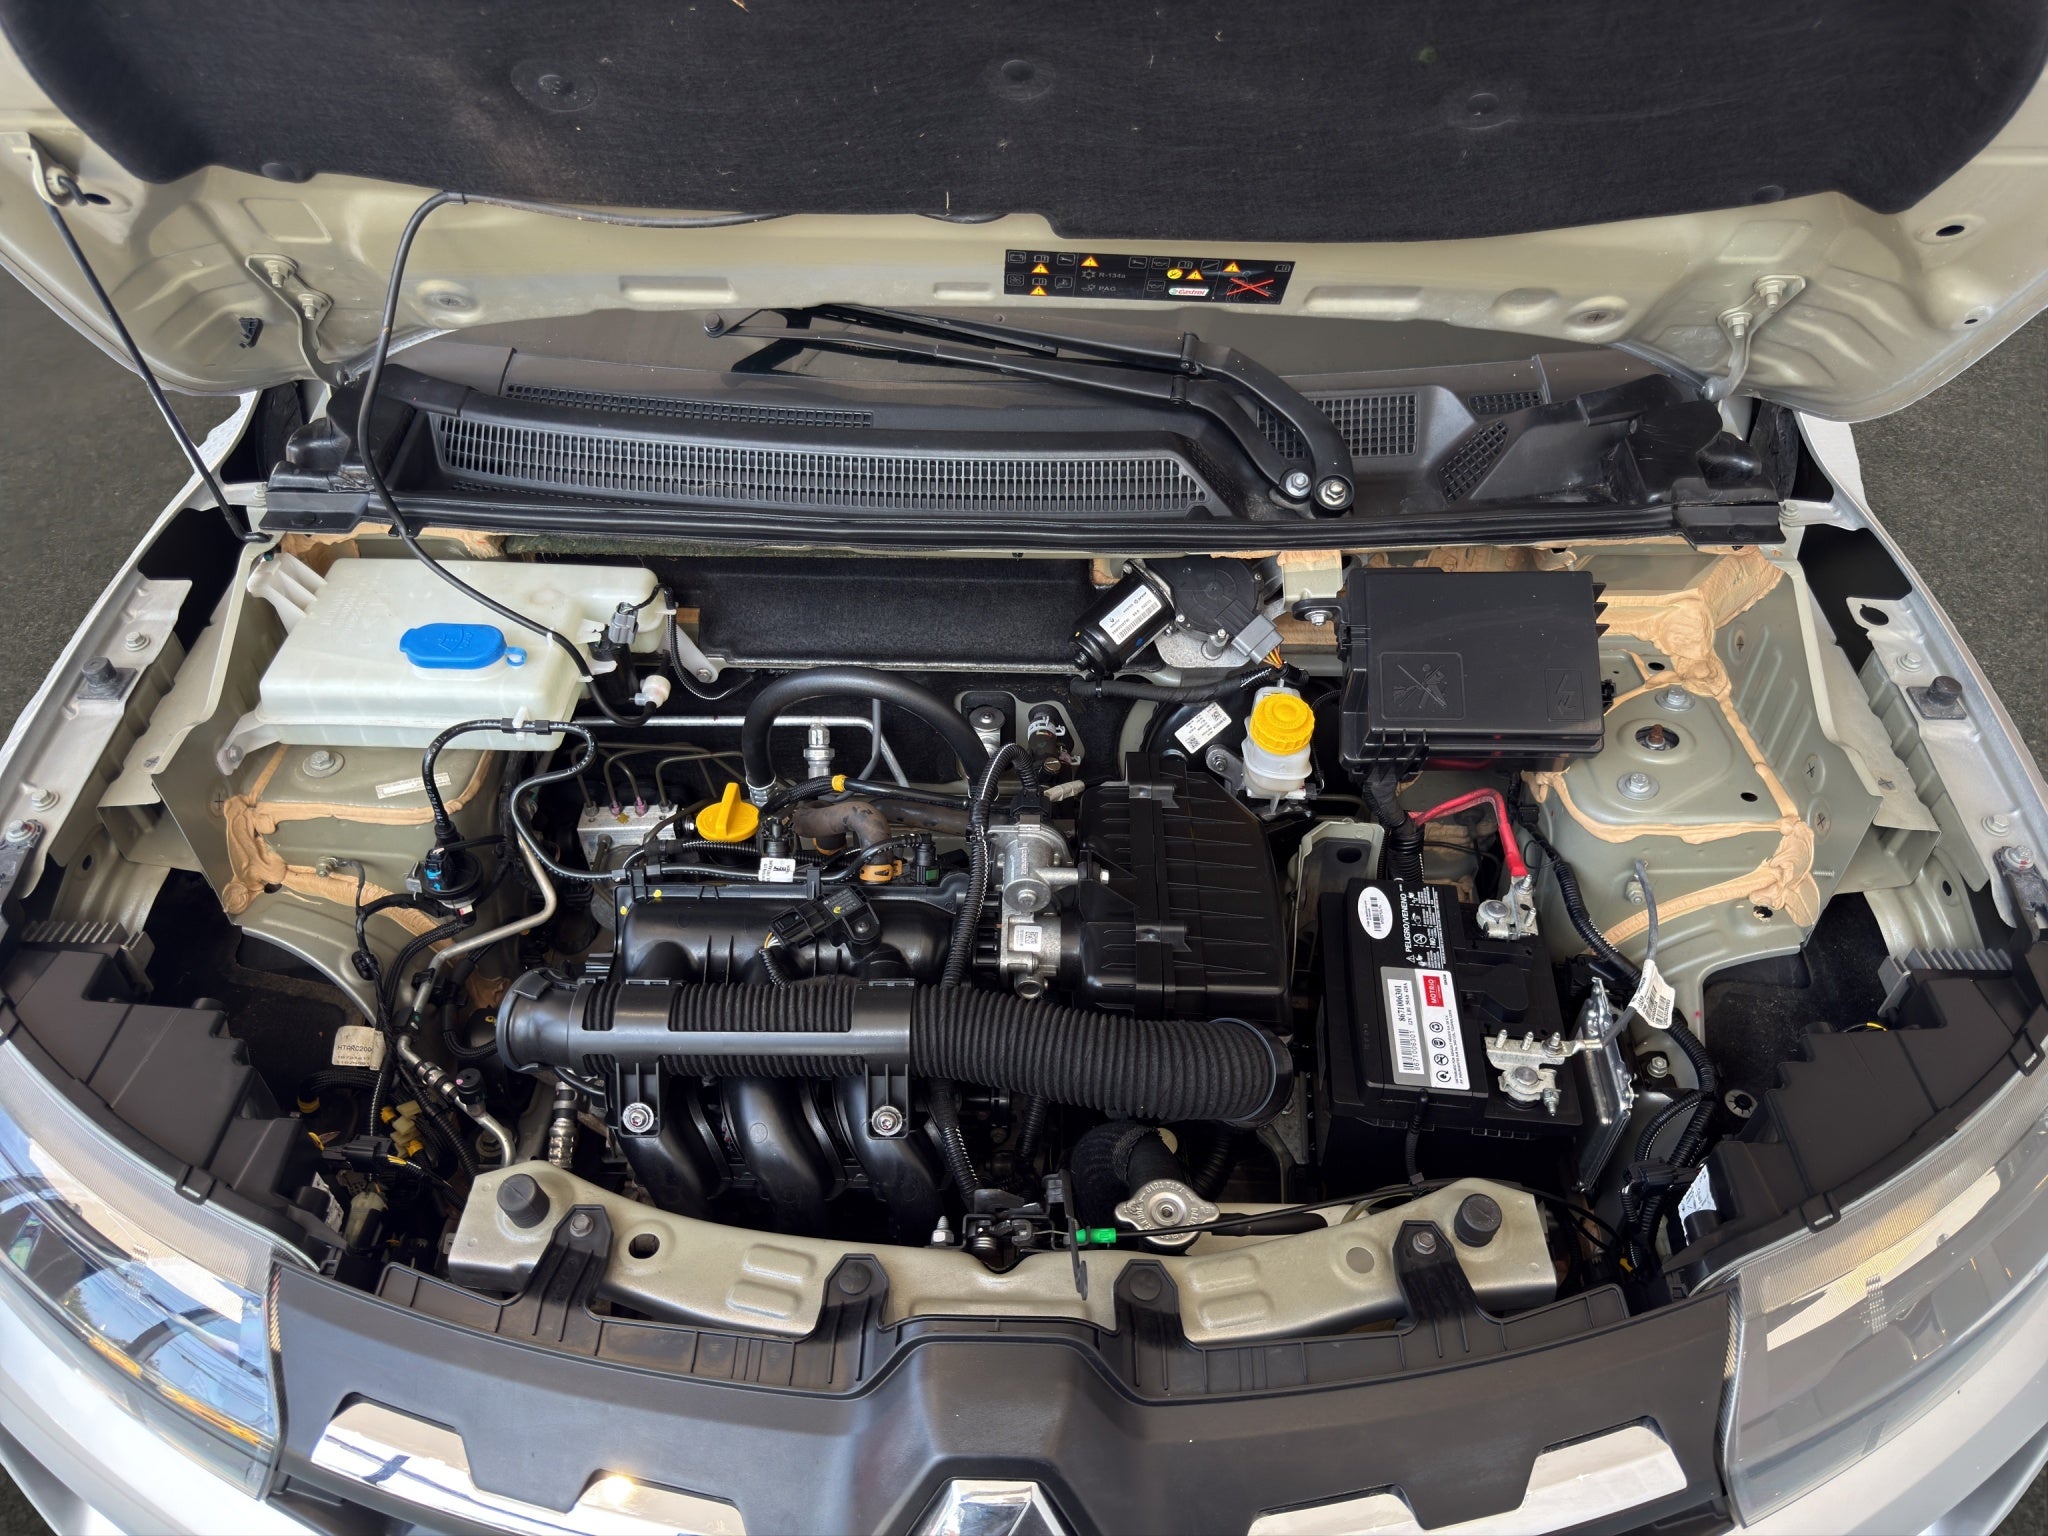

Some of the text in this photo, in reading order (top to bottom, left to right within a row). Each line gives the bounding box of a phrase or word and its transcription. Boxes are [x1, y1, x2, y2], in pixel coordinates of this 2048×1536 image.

[1177, 288, 1206, 296] Castrol
[1400, 894, 1412, 953] PELIGRO/VENENO
[1395, 985, 1407, 1021] 8671006301
[1428, 979, 1438, 1004] MOTRIO
[1410, 1030, 1421, 1071] 8671006301
